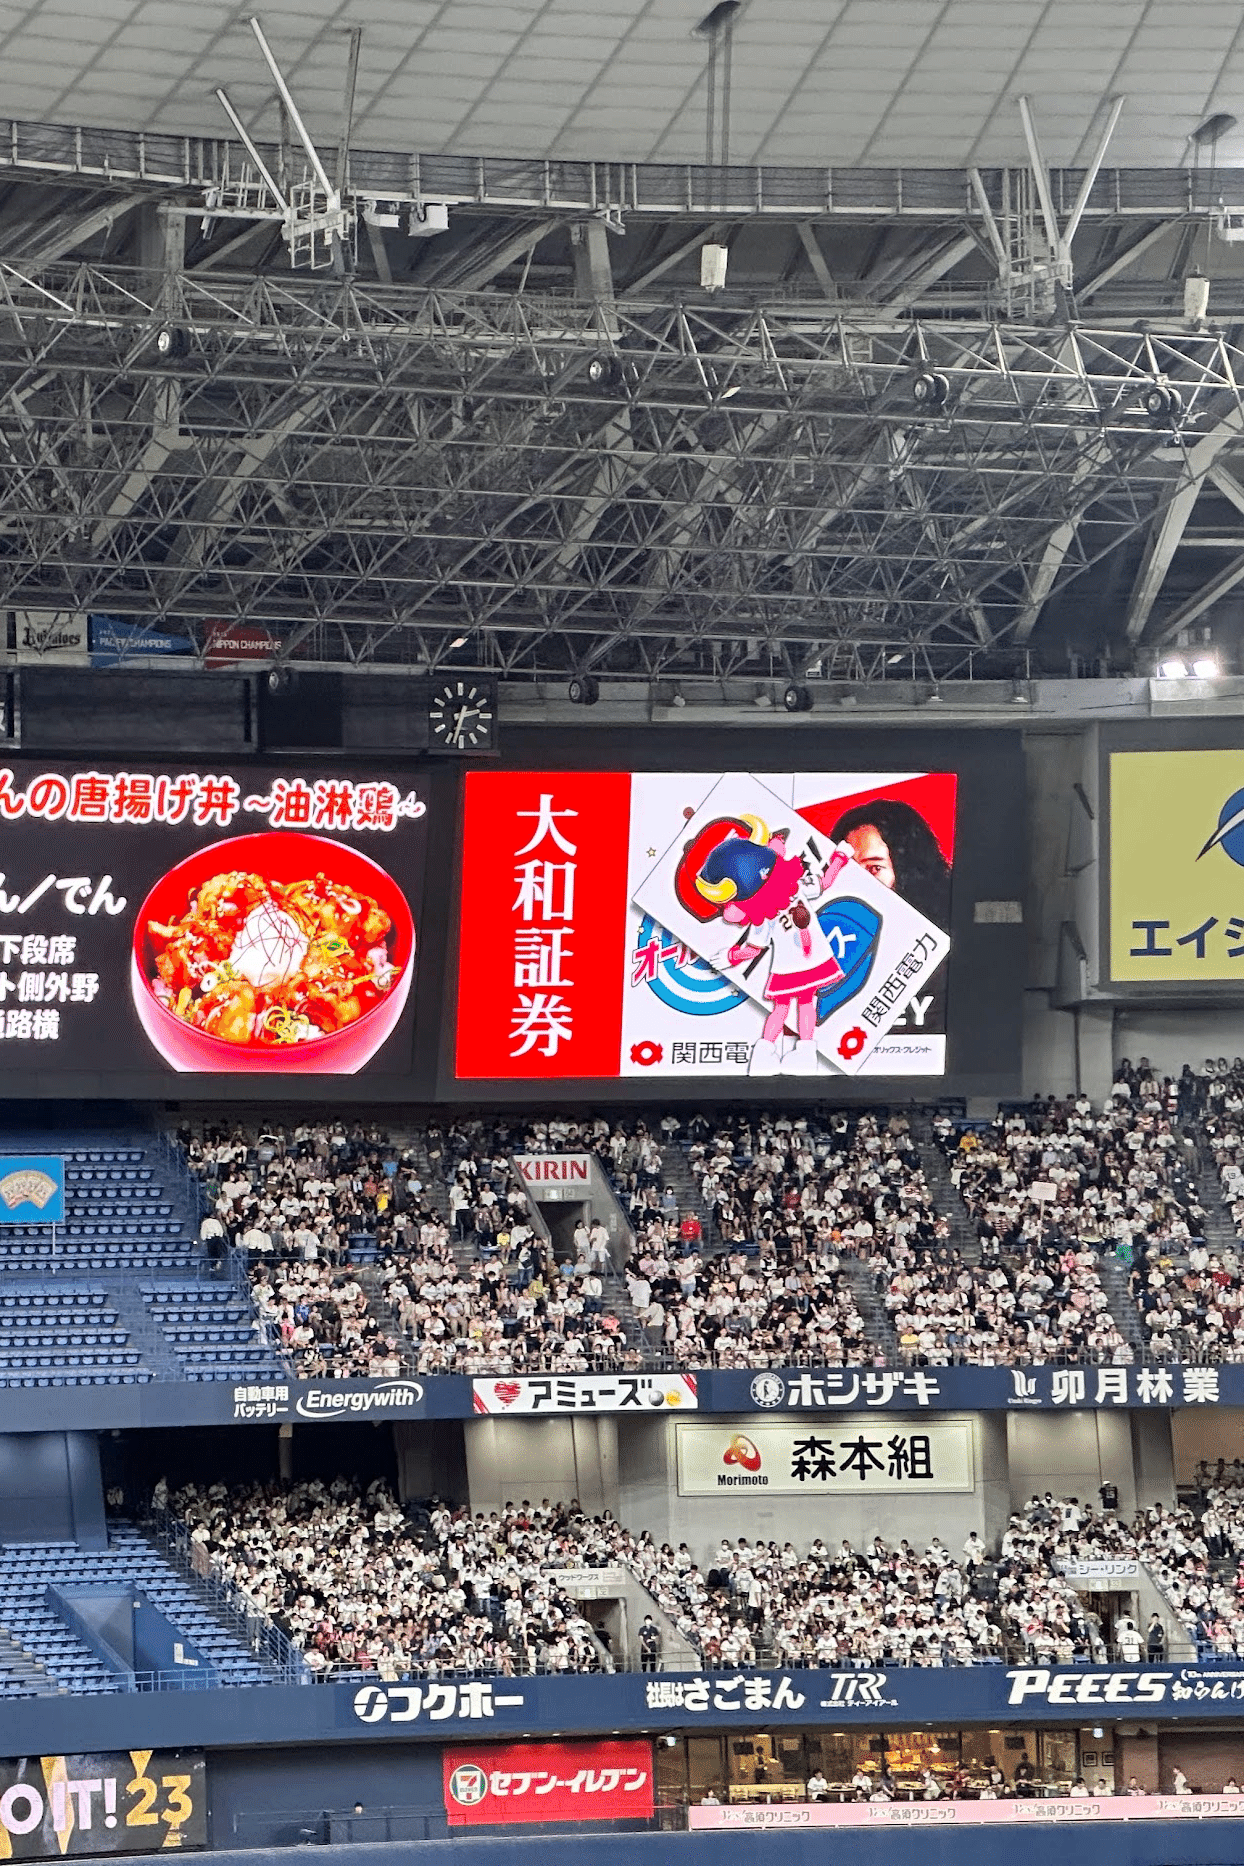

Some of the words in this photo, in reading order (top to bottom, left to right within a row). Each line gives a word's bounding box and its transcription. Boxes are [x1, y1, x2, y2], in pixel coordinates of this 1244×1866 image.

[508, 793, 580, 1058] 大和証券
[861, 932, 938, 1028] 関西電力
[671, 1041, 754, 1065] 関西電
[516, 1160, 587, 1181] KIRIN
[234, 1386, 289, 1402] 自動車用
[306, 1388, 415, 1411] Energywith
[528, 1378, 653, 1410] アミューズ
[787, 1371, 941, 1406] ホシザキ
[1051, 1367, 1220, 1405] 卯月林業
[233, 1402, 289, 1418] バッテリー
[790, 1434, 934, 1481] 森本組
[717, 1474, 769, 1486] Morimoto
[1006, 1669, 1174, 1704] PEEES
[53, 1778, 117, 1832] IT!
[125, 1774, 193, 1827] 23
